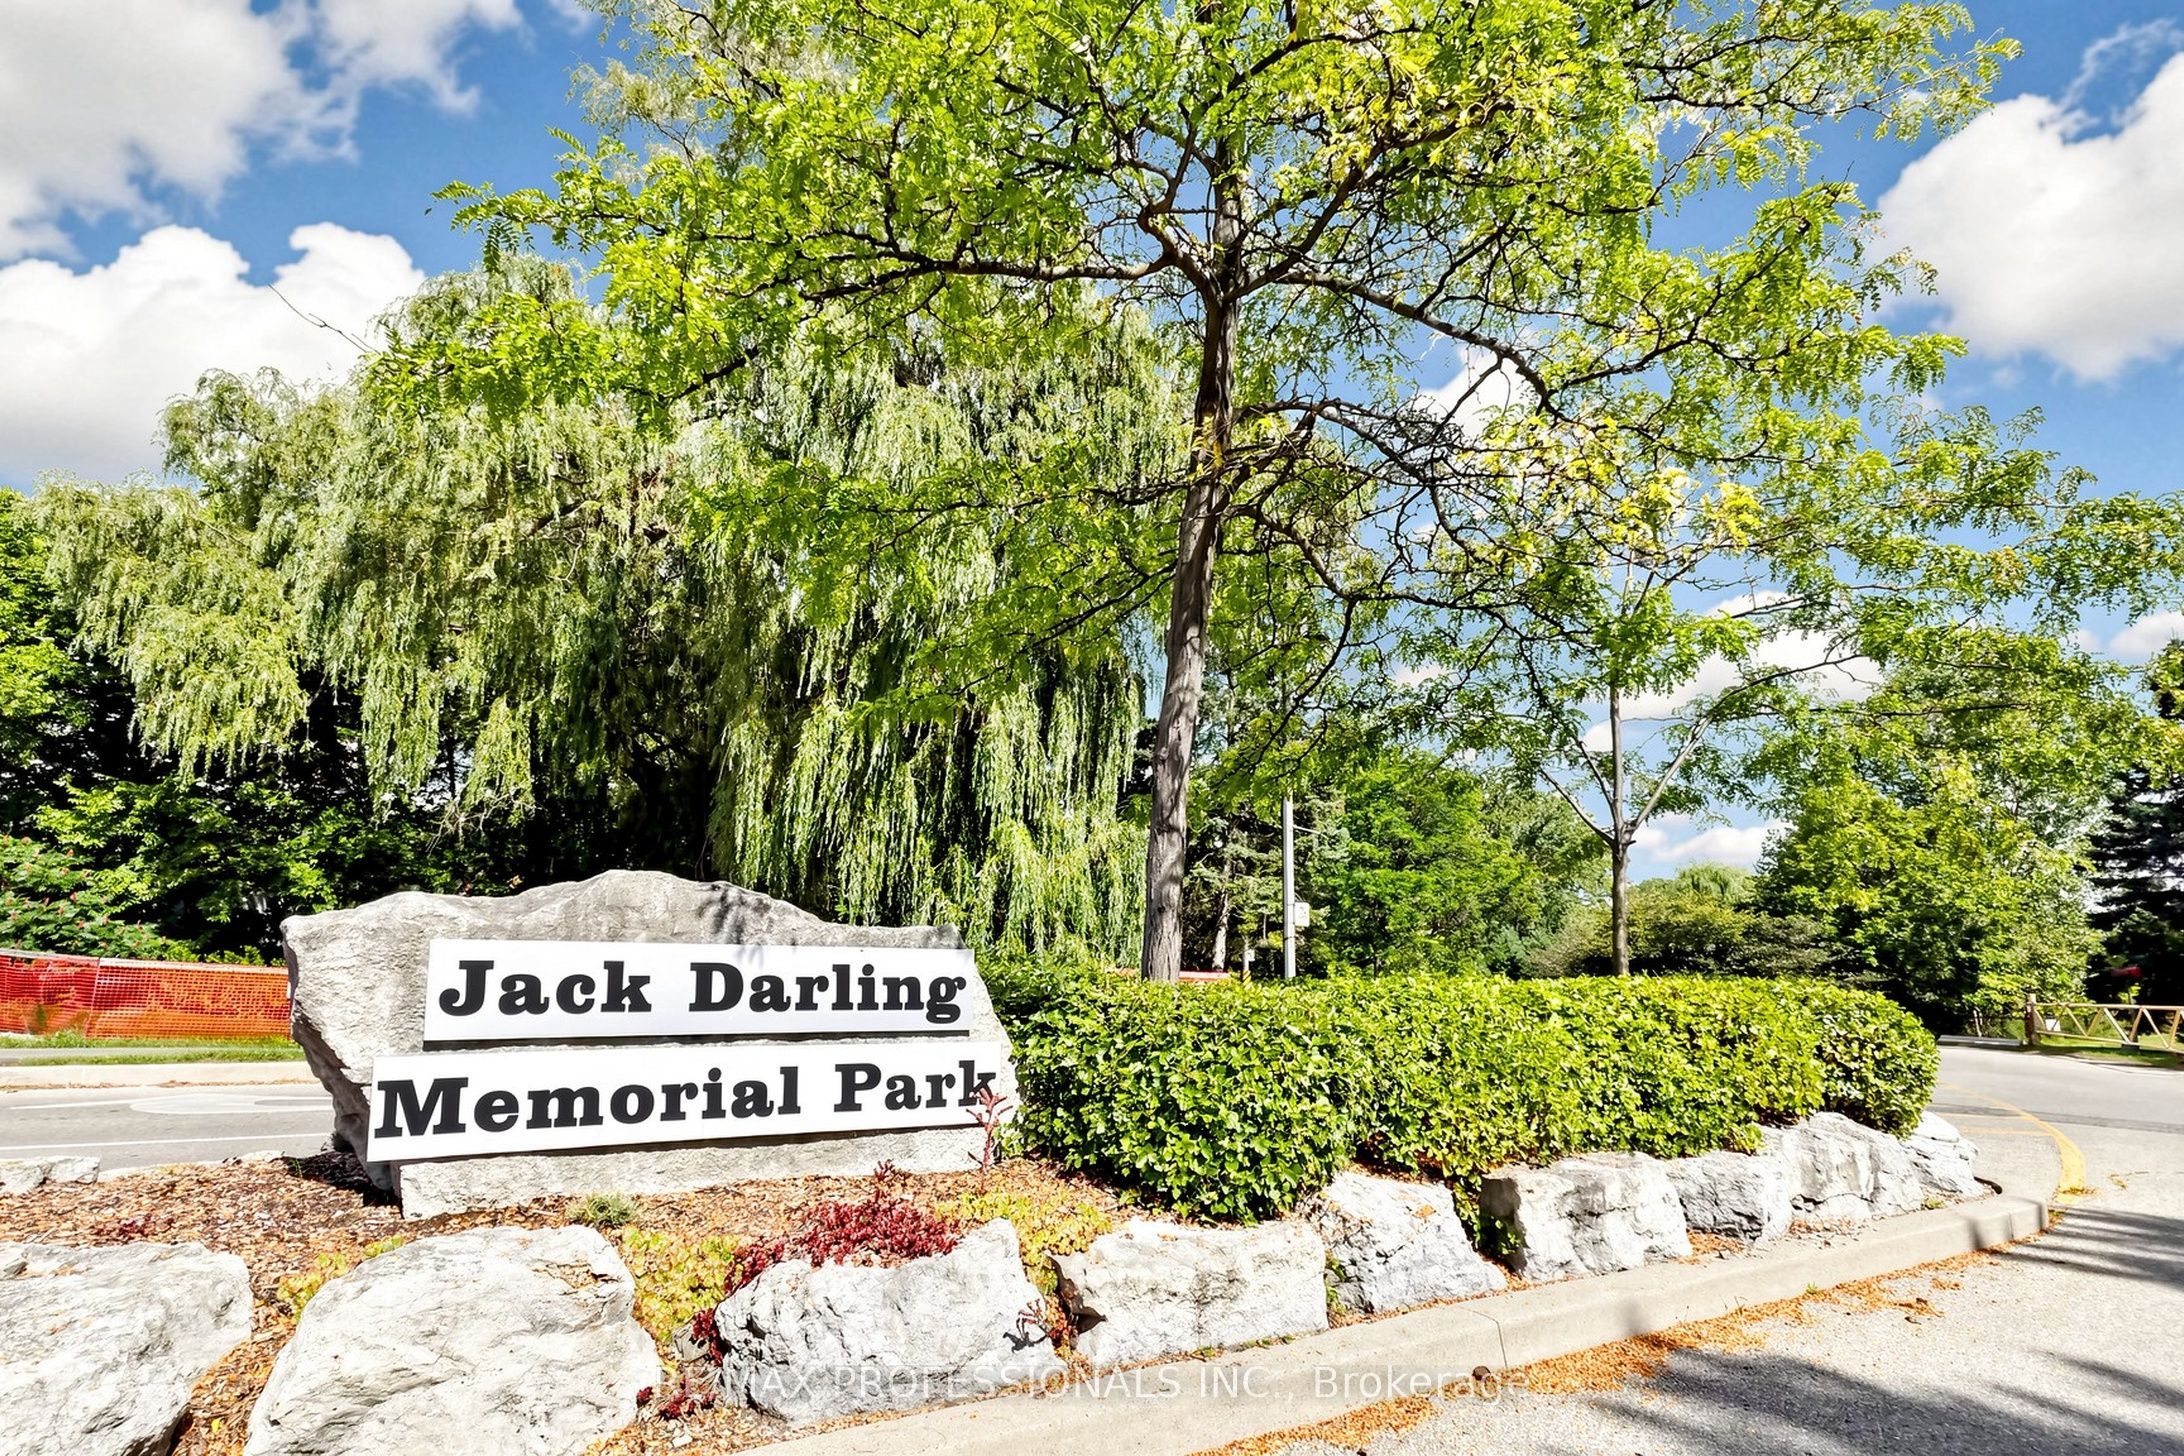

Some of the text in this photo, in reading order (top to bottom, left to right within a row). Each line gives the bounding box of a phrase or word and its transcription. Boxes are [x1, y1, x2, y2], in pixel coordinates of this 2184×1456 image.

[439, 960, 967, 1024] Jack Darling
[374, 1060, 996, 1139] Memorial Park
